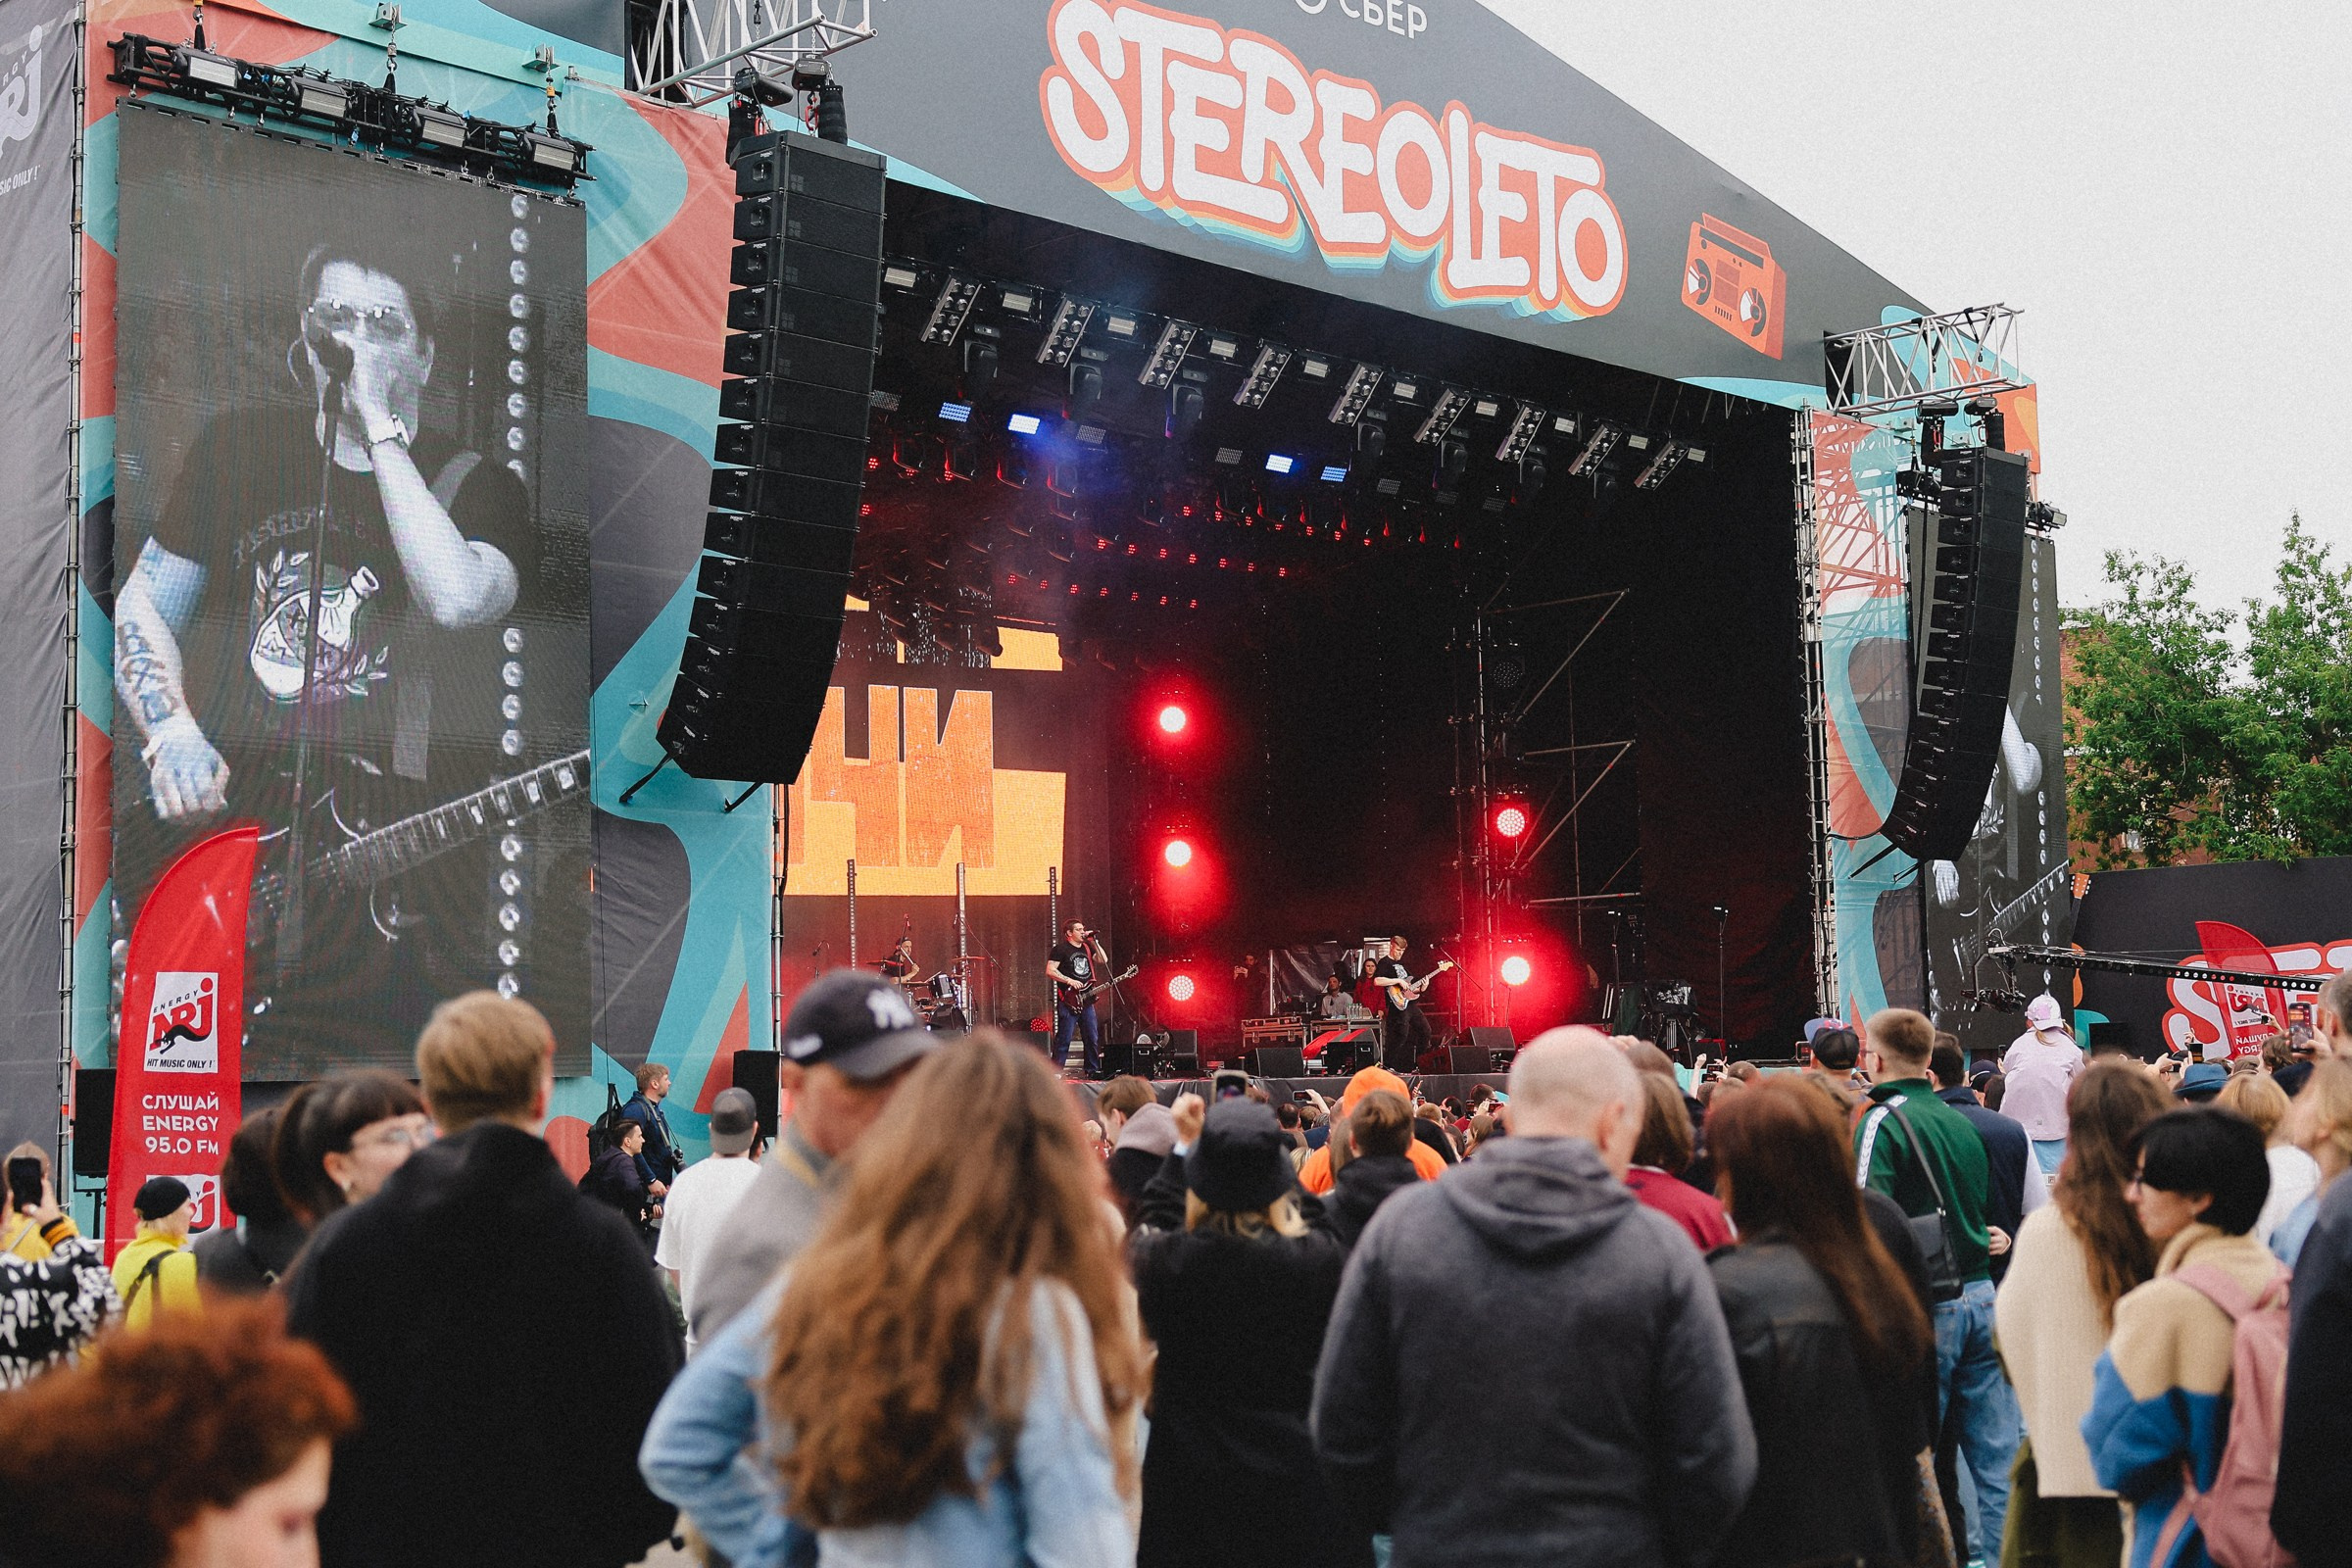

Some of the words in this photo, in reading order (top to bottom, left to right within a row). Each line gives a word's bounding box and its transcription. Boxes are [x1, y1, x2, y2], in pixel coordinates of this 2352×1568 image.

[1043, 0, 1626, 312] STEREOLETO
[13, 169, 32, 189] ONLY
[154, 990, 198, 1013] ENERGY
[147, 1058, 159, 1067] HIT
[160, 1059, 185, 1068] MUSIC
[187, 1059, 207, 1069] ONLY
[142, 1091, 220, 1111] СЛУШАЙ
[142, 1115, 220, 1132] ENERGY
[145, 1136, 192, 1154] 95.0
[196, 1140, 220, 1155] FM
